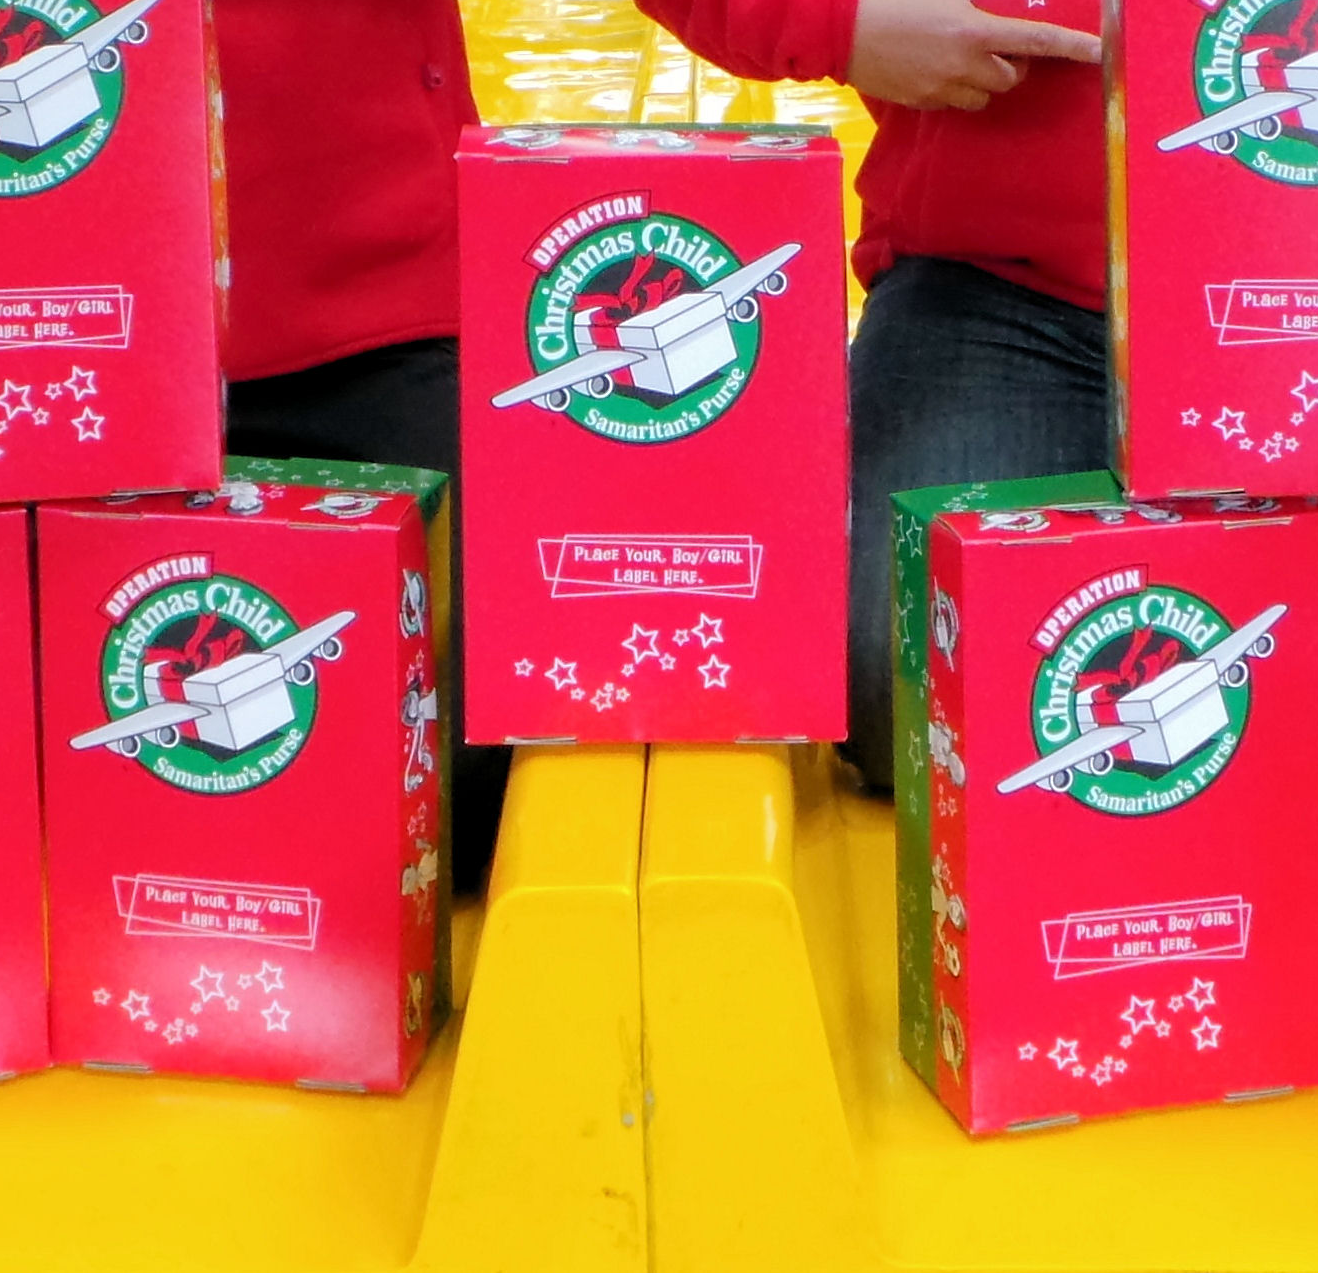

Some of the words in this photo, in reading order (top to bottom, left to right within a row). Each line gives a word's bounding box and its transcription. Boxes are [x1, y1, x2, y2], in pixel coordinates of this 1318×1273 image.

[62, 117, 110, 170] Purse
[533, 196, 643, 266] OPERATION
[535, 231, 635, 361] Christmas
[641, 222, 728, 281] Child
[585, 408, 701, 441] Samaritan's
[697, 366, 746, 418] Purse
[106, 555, 207, 620] OPERATION
[1035, 570, 1141, 646] OPERATION
[109, 589, 199, 709] Christmas
[205, 584, 285, 644] Child
[1041, 599, 1133, 742] Christmas
[1138, 594, 1221, 649] Child
[153, 756, 263, 793] Samaritan's
[260, 727, 303, 776] Purse
[1086, 779, 1196, 814] Samaritan's
[1193, 731, 1237, 783] Purse
